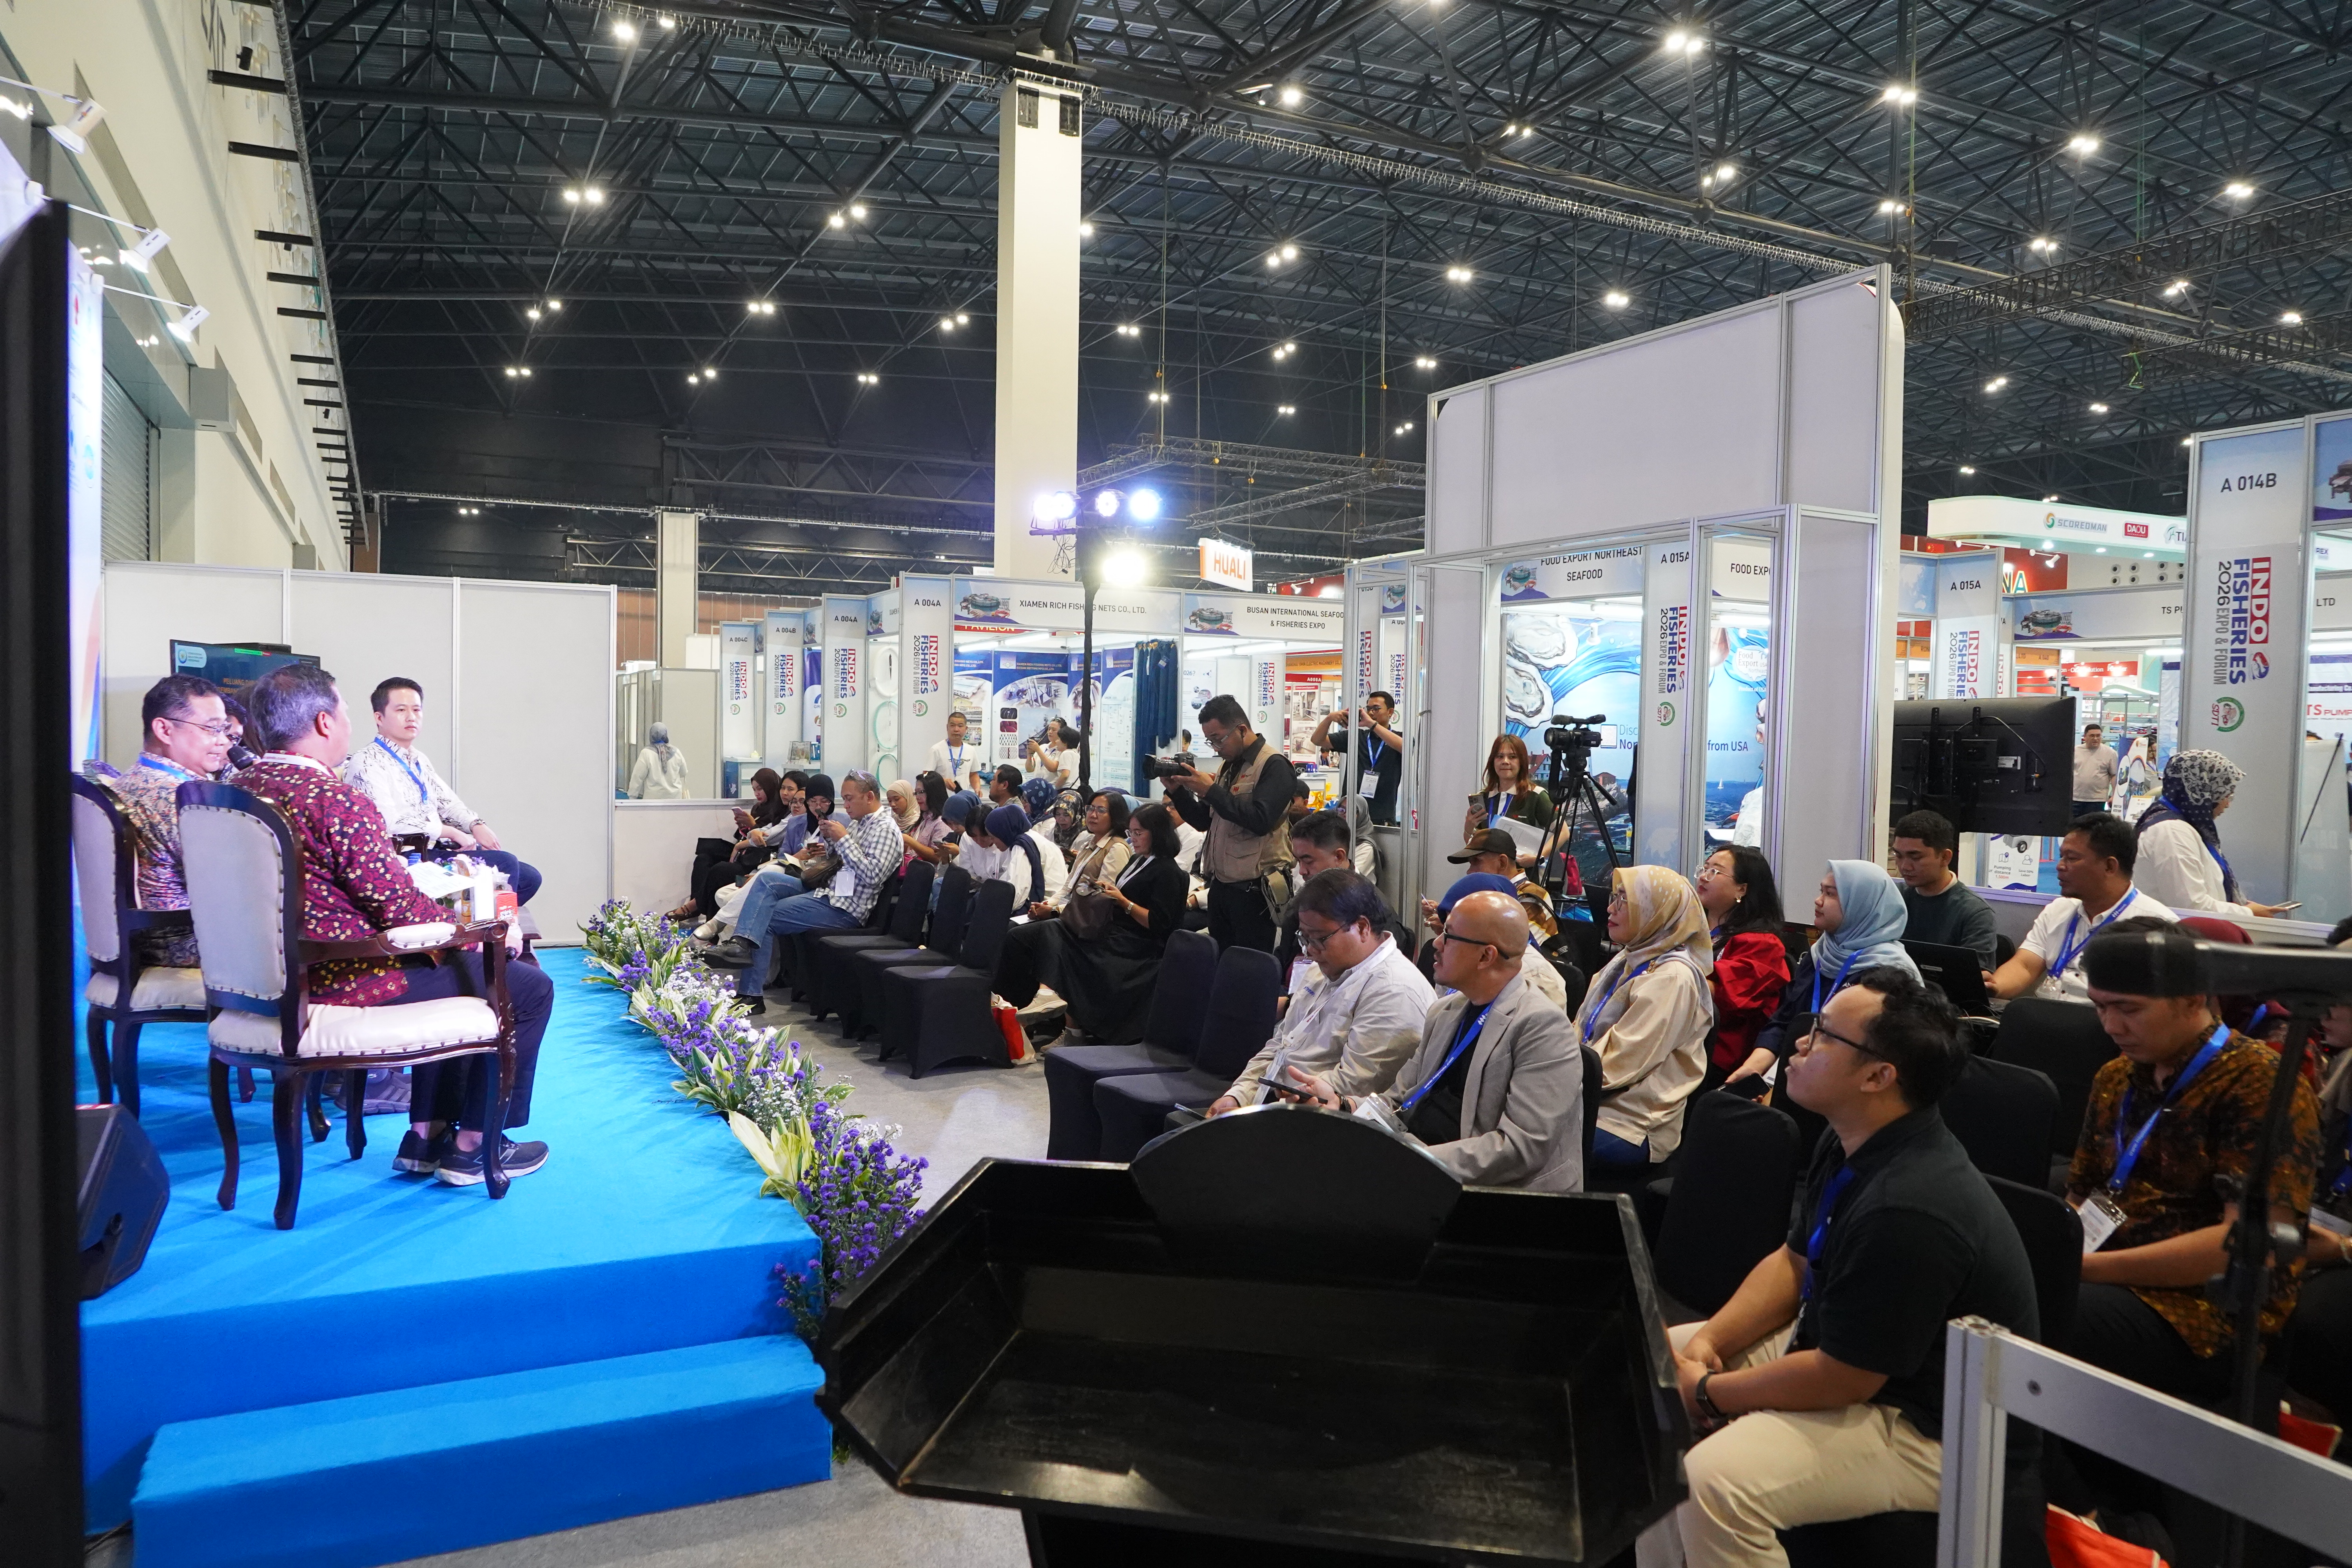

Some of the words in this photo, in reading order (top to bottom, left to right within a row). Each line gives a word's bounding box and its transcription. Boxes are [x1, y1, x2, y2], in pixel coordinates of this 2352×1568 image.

[2221, 477, 2232, 492] A
[2238, 473, 2277, 490] 014B
[2127, 524, 2146, 534] DAOU
[2176, 532, 2186, 541] TI
[1214, 550, 1246, 580] HUALI
[1541, 556, 1561, 566] FOOD
[1563, 553, 1591, 563] EXPORT
[1595, 546, 1643, 560] NORTHEAST
[1661, 554, 1667, 564] A
[1567, 569, 1602, 581] SEAFOOD
[1731, 563, 1751, 574] FOOD
[1754, 566, 1770, 575] EXP
[1951, 582, 1957, 591] A
[1960, 580, 1981, 590] 015A
[2217, 561, 2231, 606] 2026
[1020, 600, 1047, 608] XIAMEN
[1069, 603, 1096, 611] FISHG
[2249, 557, 2271, 644] INDO
[2316, 598, 2336, 607] LTD
[1270, 608, 1319, 617] INTERNATIONAL
[2215, 608, 2229, 634] EXPO
[2229, 559, 2250, 684] FISHERIES
[929, 635, 938, 675] INDO
[1667, 607, 1678, 693] FISHERIES
[1949, 632, 1958, 659] 2026
[920, 635, 929, 694] FISHERIES
[1739, 659, 1758, 668] Export
[1956, 631, 1968, 699] FISHERIE
[1967, 631, 1980, 682] INDO
[2213, 648, 2227, 685] FORUM
[1619, 724, 1638, 735] Disc
[1708, 740, 1729, 752] from
[1731, 741, 1748, 751] USA
